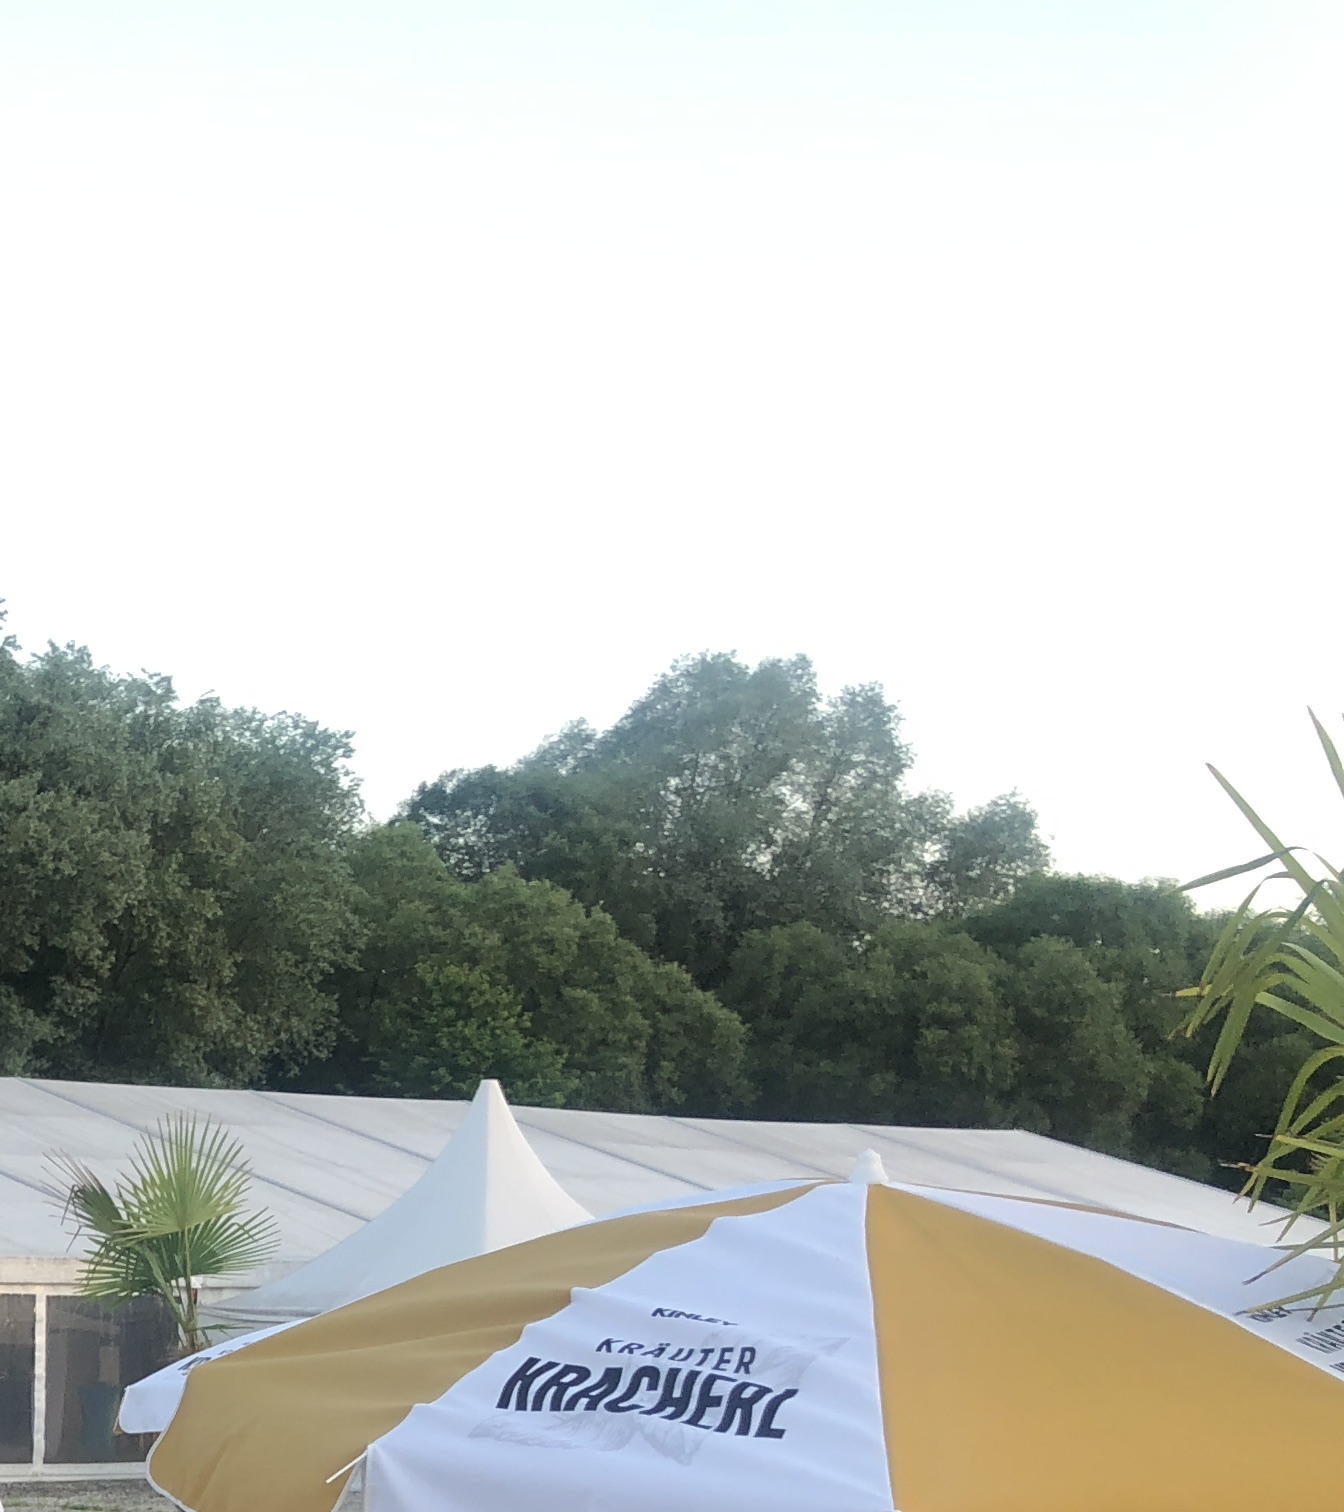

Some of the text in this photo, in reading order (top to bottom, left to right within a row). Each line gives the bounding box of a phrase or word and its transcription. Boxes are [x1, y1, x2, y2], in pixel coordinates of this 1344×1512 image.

[650, 1307, 740, 1326] KINLEY
[595, 1337, 757, 1375] KRÄUTER
[495, 1356, 800, 1439] KRACHERL
